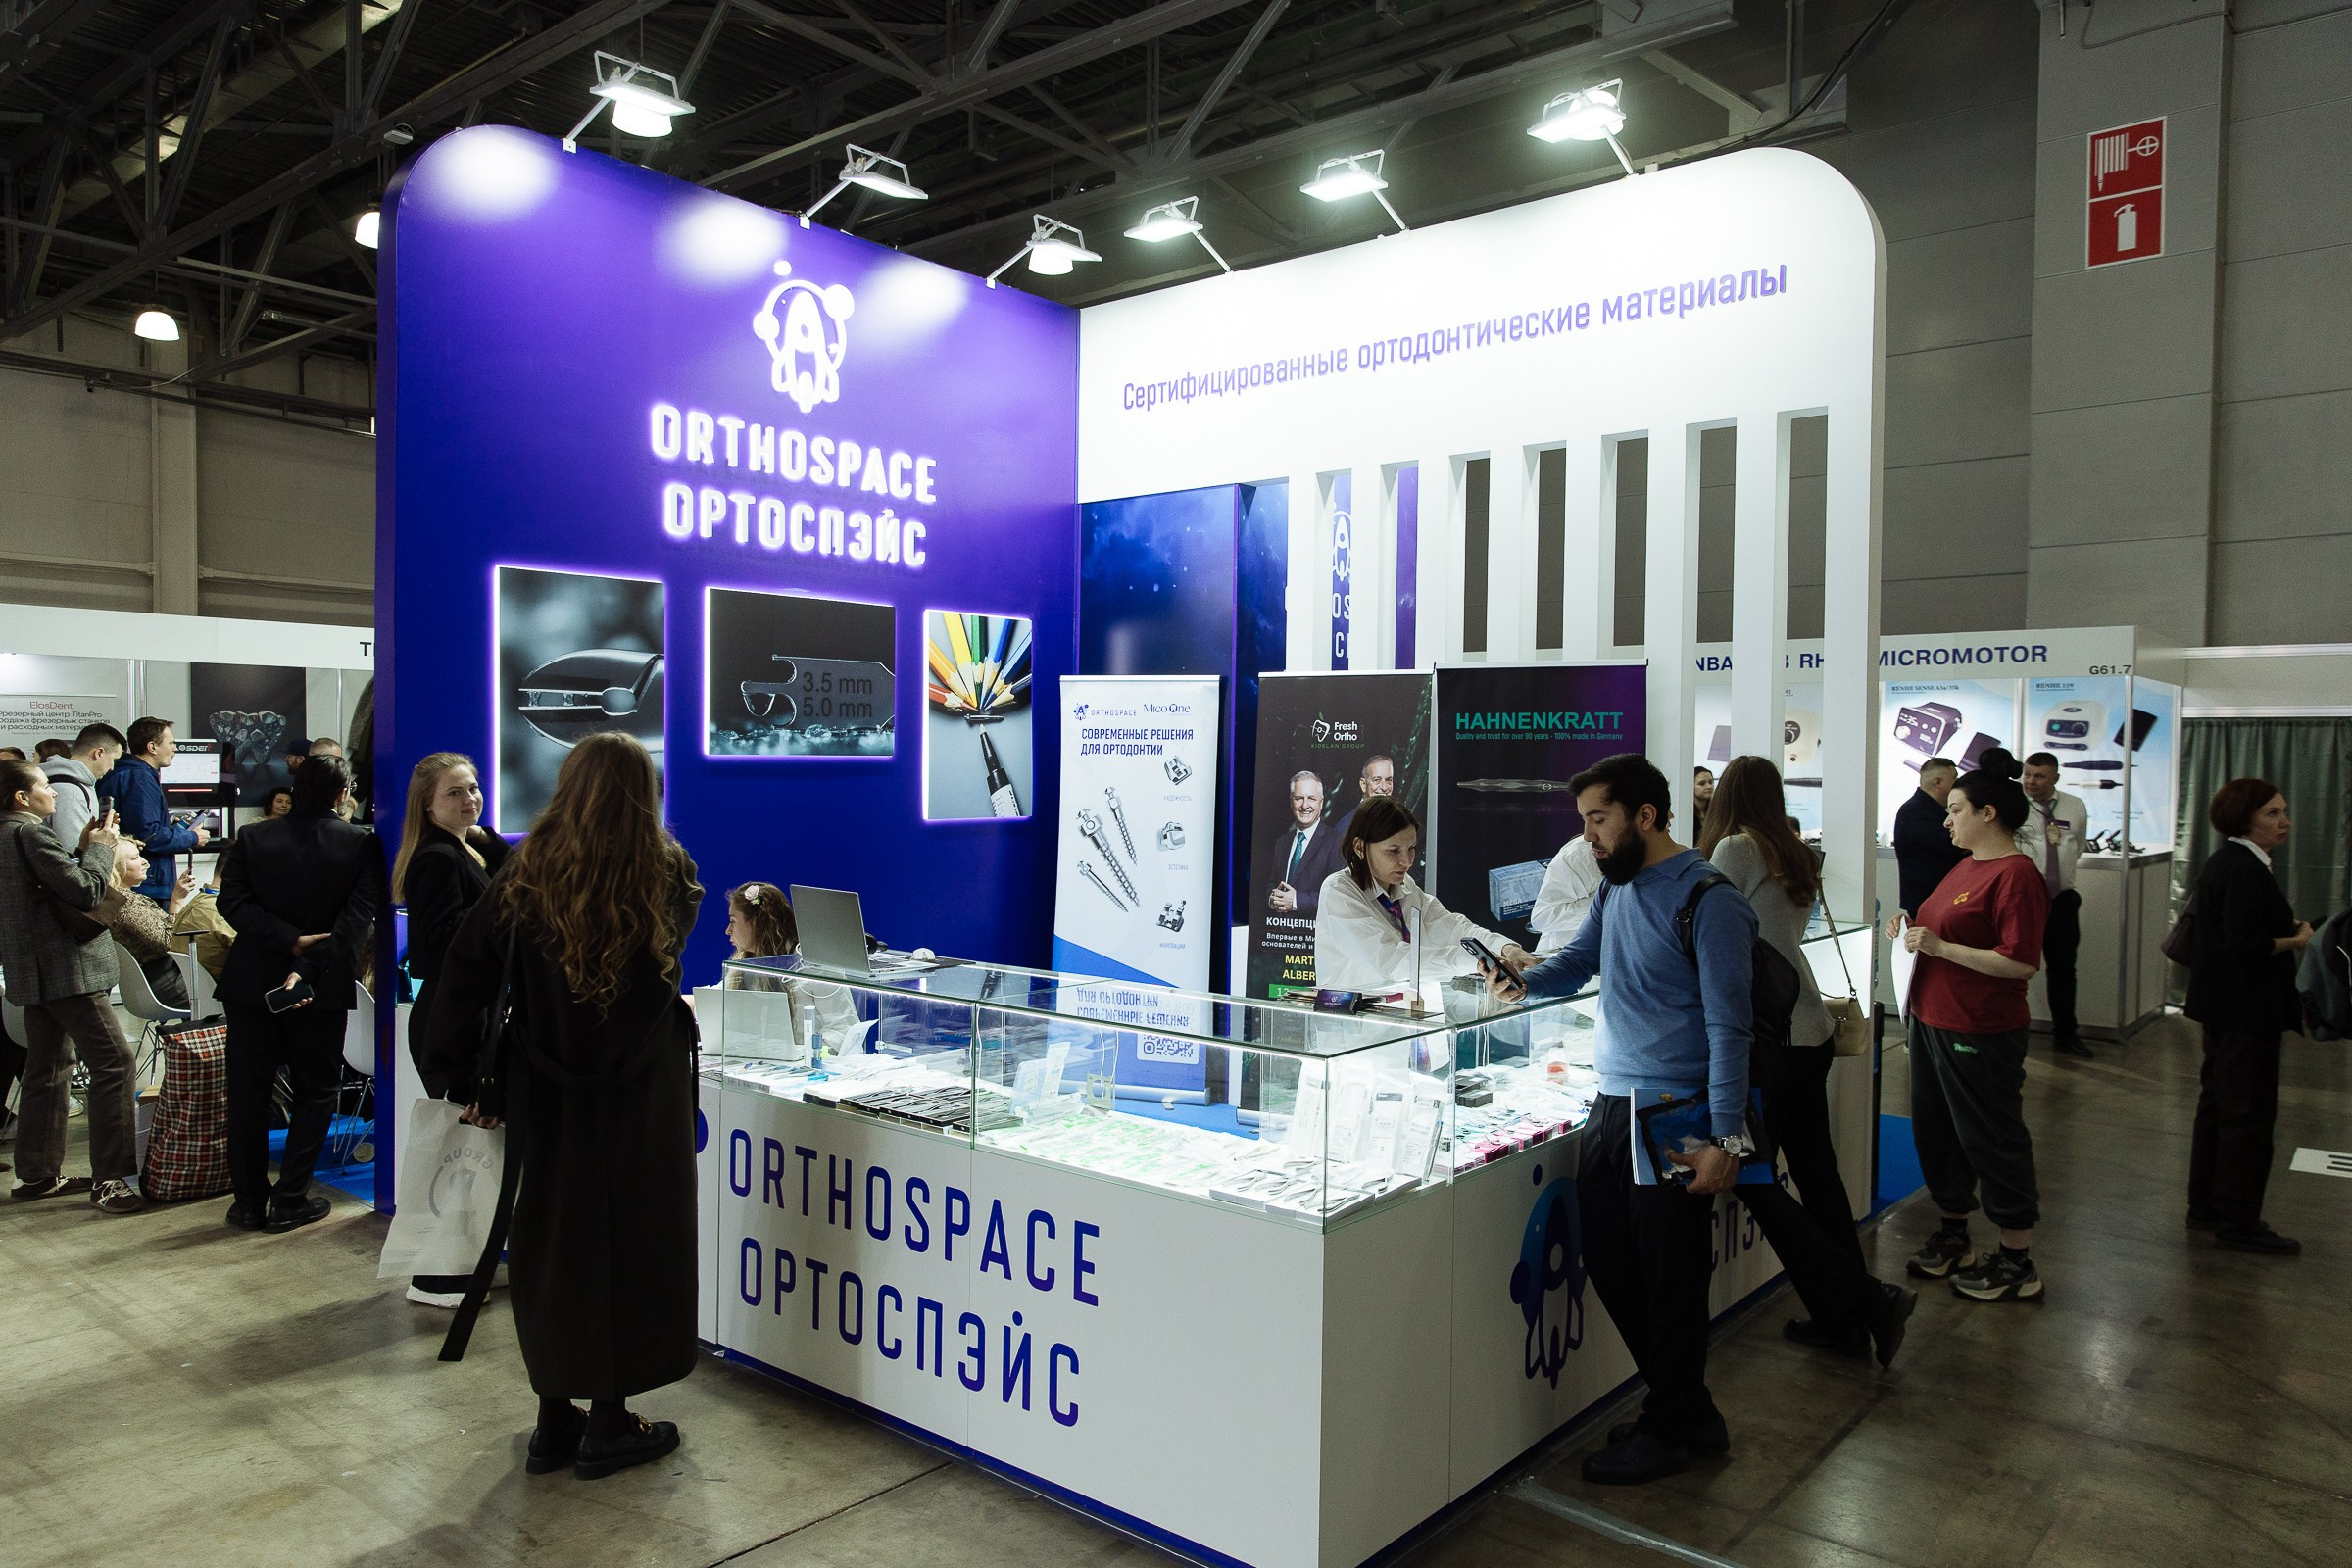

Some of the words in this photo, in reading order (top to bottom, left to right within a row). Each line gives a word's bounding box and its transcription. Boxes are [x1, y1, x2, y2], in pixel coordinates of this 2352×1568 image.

[1124, 348, 1348, 412] Сертифицированные
[1358, 302, 1590, 372] ортодонтические
[1602, 265, 1787, 325] материалы
[651, 404, 938, 504] ORTHOSPACE
[663, 484, 927, 566] ОРТОСПЭЙС
[2089, 665, 2132, 675] G61.7
[803, 672, 832, 693] 3.5
[839, 678, 872, 694] mm
[29, 701, 74, 710] ElosDent
[803, 697, 832, 717] 5.0
[839, 703, 872, 717] mm
[1334, 721, 1357, 730] Fresh
[1456, 712, 1623, 730] HAHNENKRATT
[1082, 728, 1148, 740] СОВРЕМЕННЫЕ
[1152, 729, 1194, 740] РЕШЕНИЯ
[1334, 732, 1357, 741] Ortho
[1081, 744, 1101, 756] ДЛЯ
[1103, 744, 1163, 756] ОРТОДОНТИИ
[1266, 932, 1298, 941] Впервые
[1262, 941, 1306, 950] основателей
[1285, 955, 1315, 965] MART
[1283, 969, 1315, 981] ALBER
[729, 1128, 1100, 1307] ORTHOSPACE
[740, 1237, 1079, 1427] ОРТОСПЭЙС
